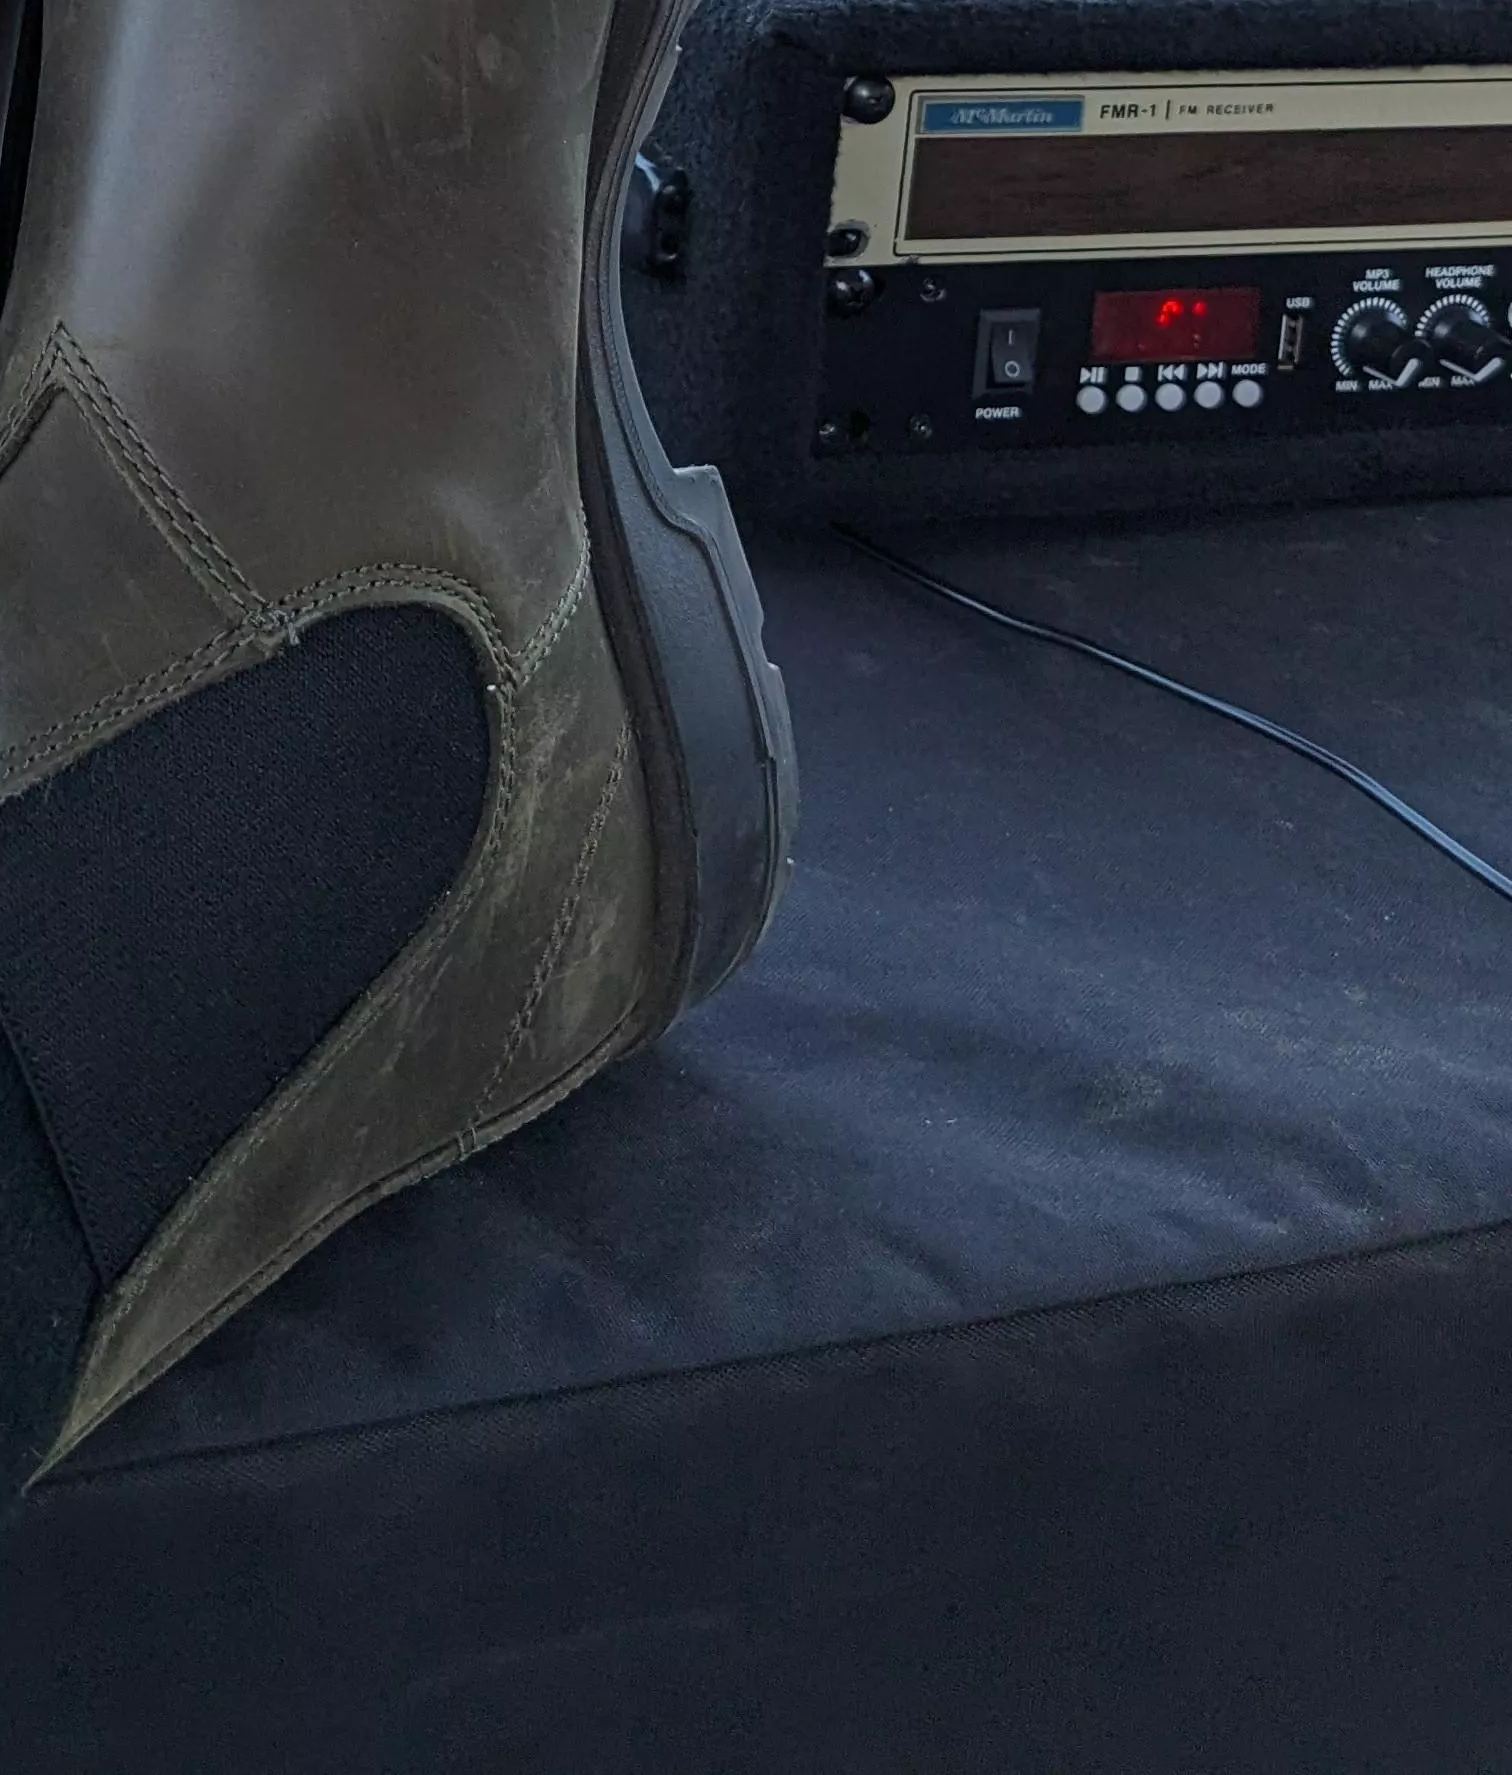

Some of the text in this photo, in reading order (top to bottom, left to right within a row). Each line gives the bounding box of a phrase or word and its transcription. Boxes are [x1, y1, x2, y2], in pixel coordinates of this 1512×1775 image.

[1099, 103, 1275, 120] FMR-1 FM RECEIVER
[1365, 269, 1390, 280] MP3
[1425, 265, 1495, 278] HEADPHONE
[1353, 279, 1401, 292] VOLUME
[1436, 276, 1483, 289] VOLUME
[1286, 297, 1311, 309] USB
[1231, 362, 1266, 376] MODE
[1336, 381, 1358, 392] MIN
[975, 406, 1022, 419] POWER
